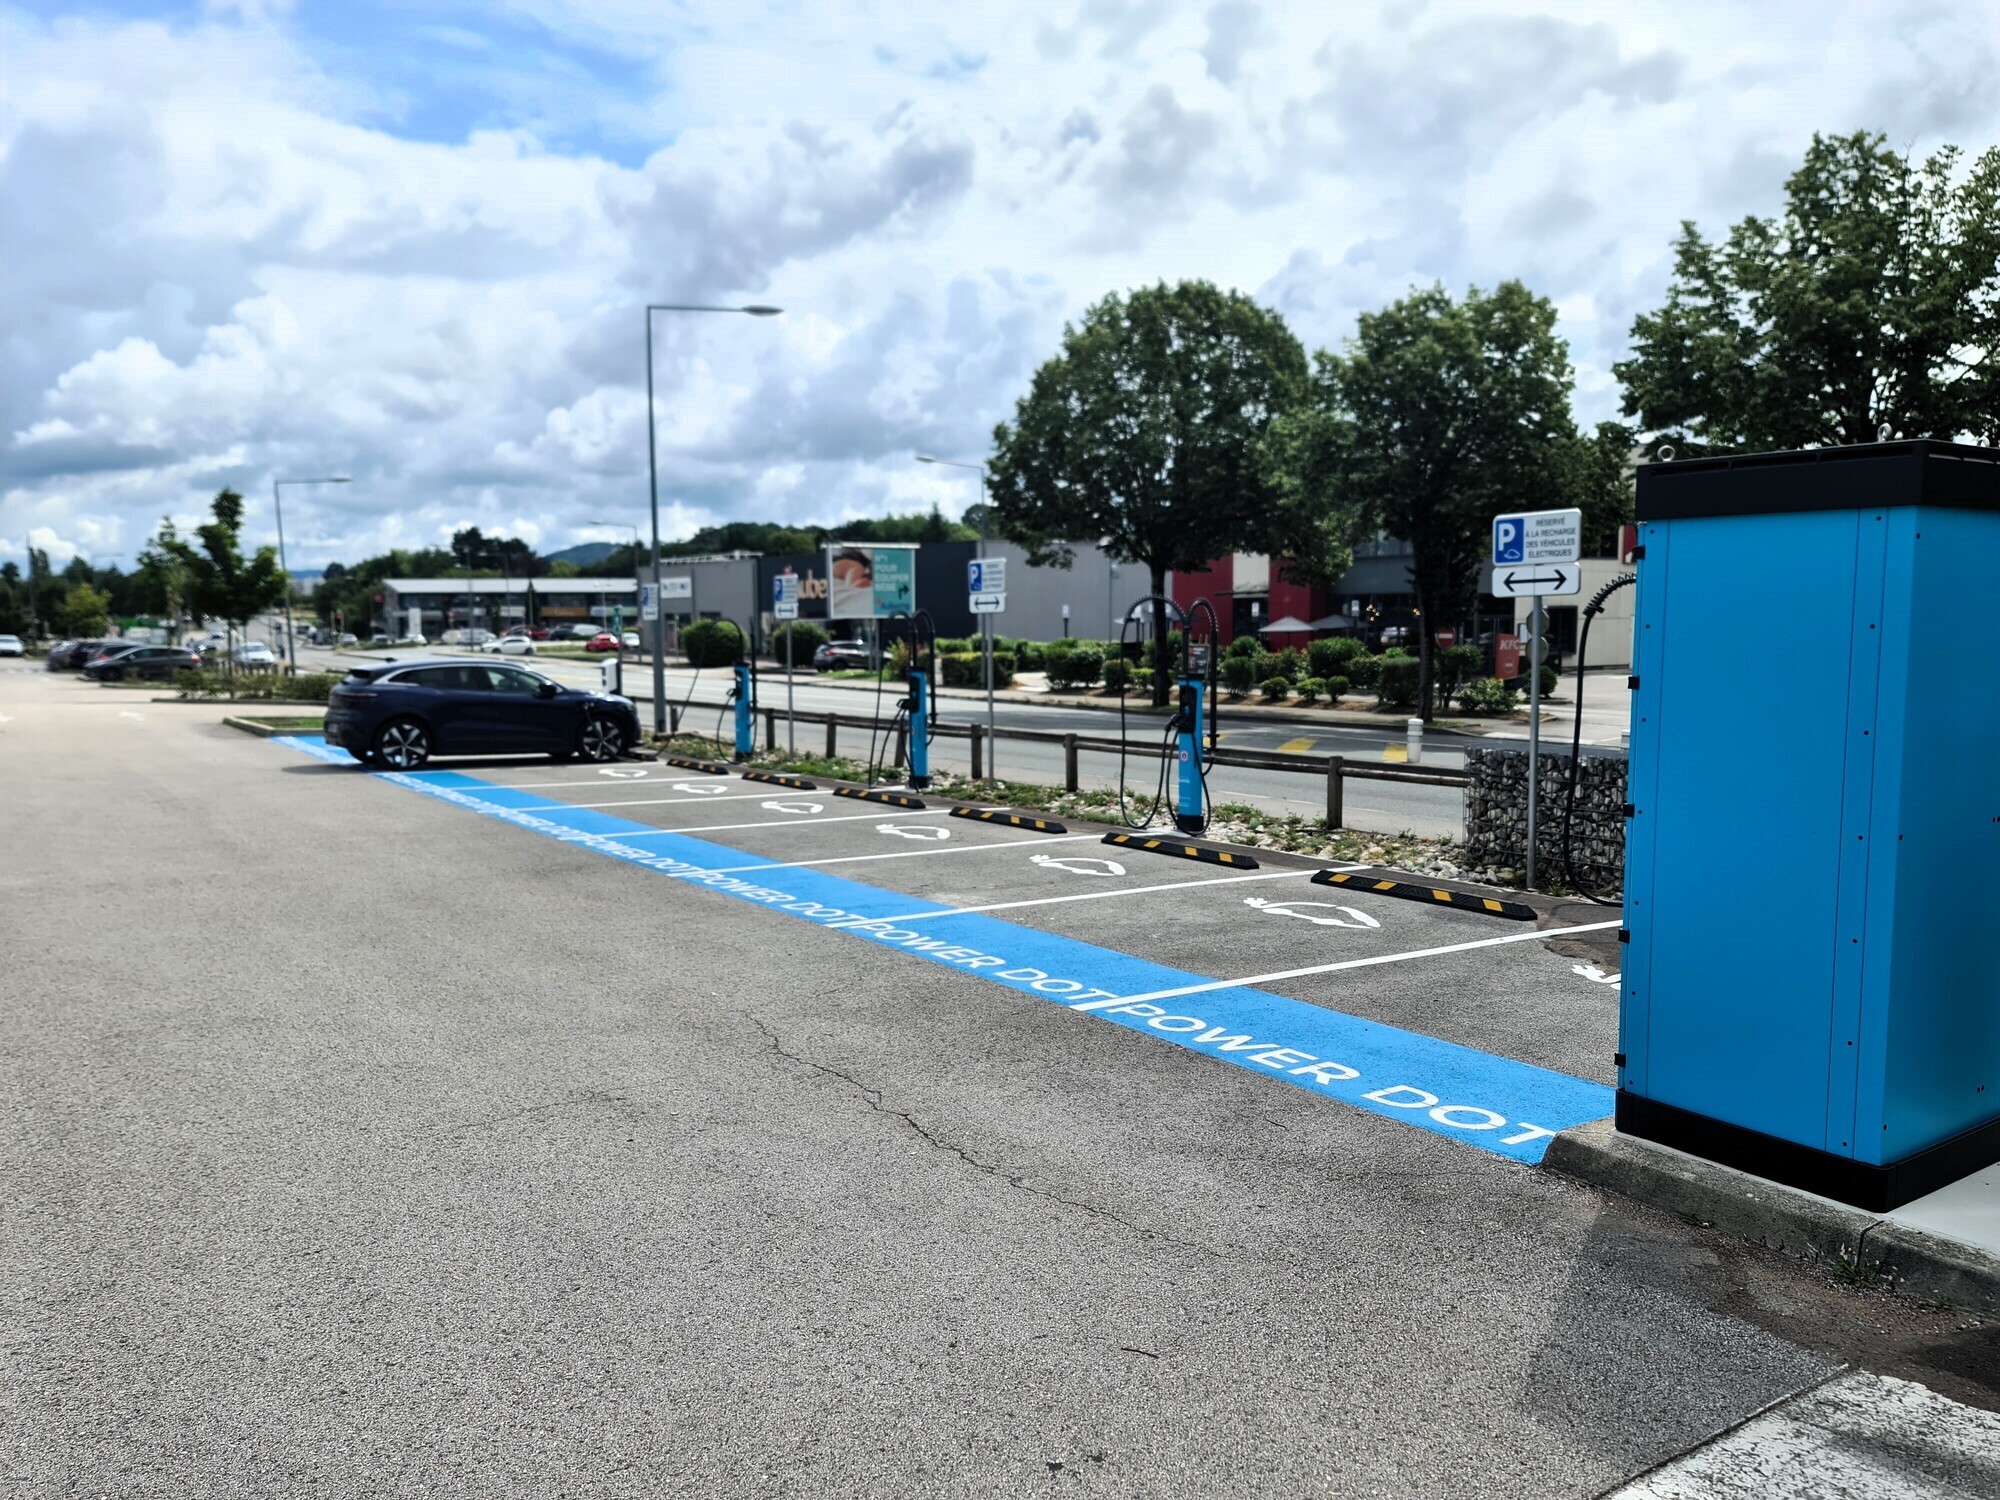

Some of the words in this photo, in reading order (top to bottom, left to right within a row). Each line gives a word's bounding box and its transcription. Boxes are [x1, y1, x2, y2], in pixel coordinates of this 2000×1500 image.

[1536, 516, 1565, 527] RÉSERVÉ
[1498, 523, 1516, 551] P
[1531, 529, 1539, 538] LA
[1540, 527, 1576, 537] RECHARGE
[1525, 540, 1538, 549] DES
[1540, 537, 1576, 547] VÉHICULES
[1528, 548, 1572, 559] ÉLECTRIQUES
[1499, 639, 1520, 650] KFC
[686, 871, 798, 902] POWER
[780, 901, 870, 922] DOT
[848, 922, 1006, 969] POWER
[993, 967, 1121, 1000] DOT
[1105, 1003, 1361, 1086] POWER
[1360, 1084, 1557, 1146] DOT
